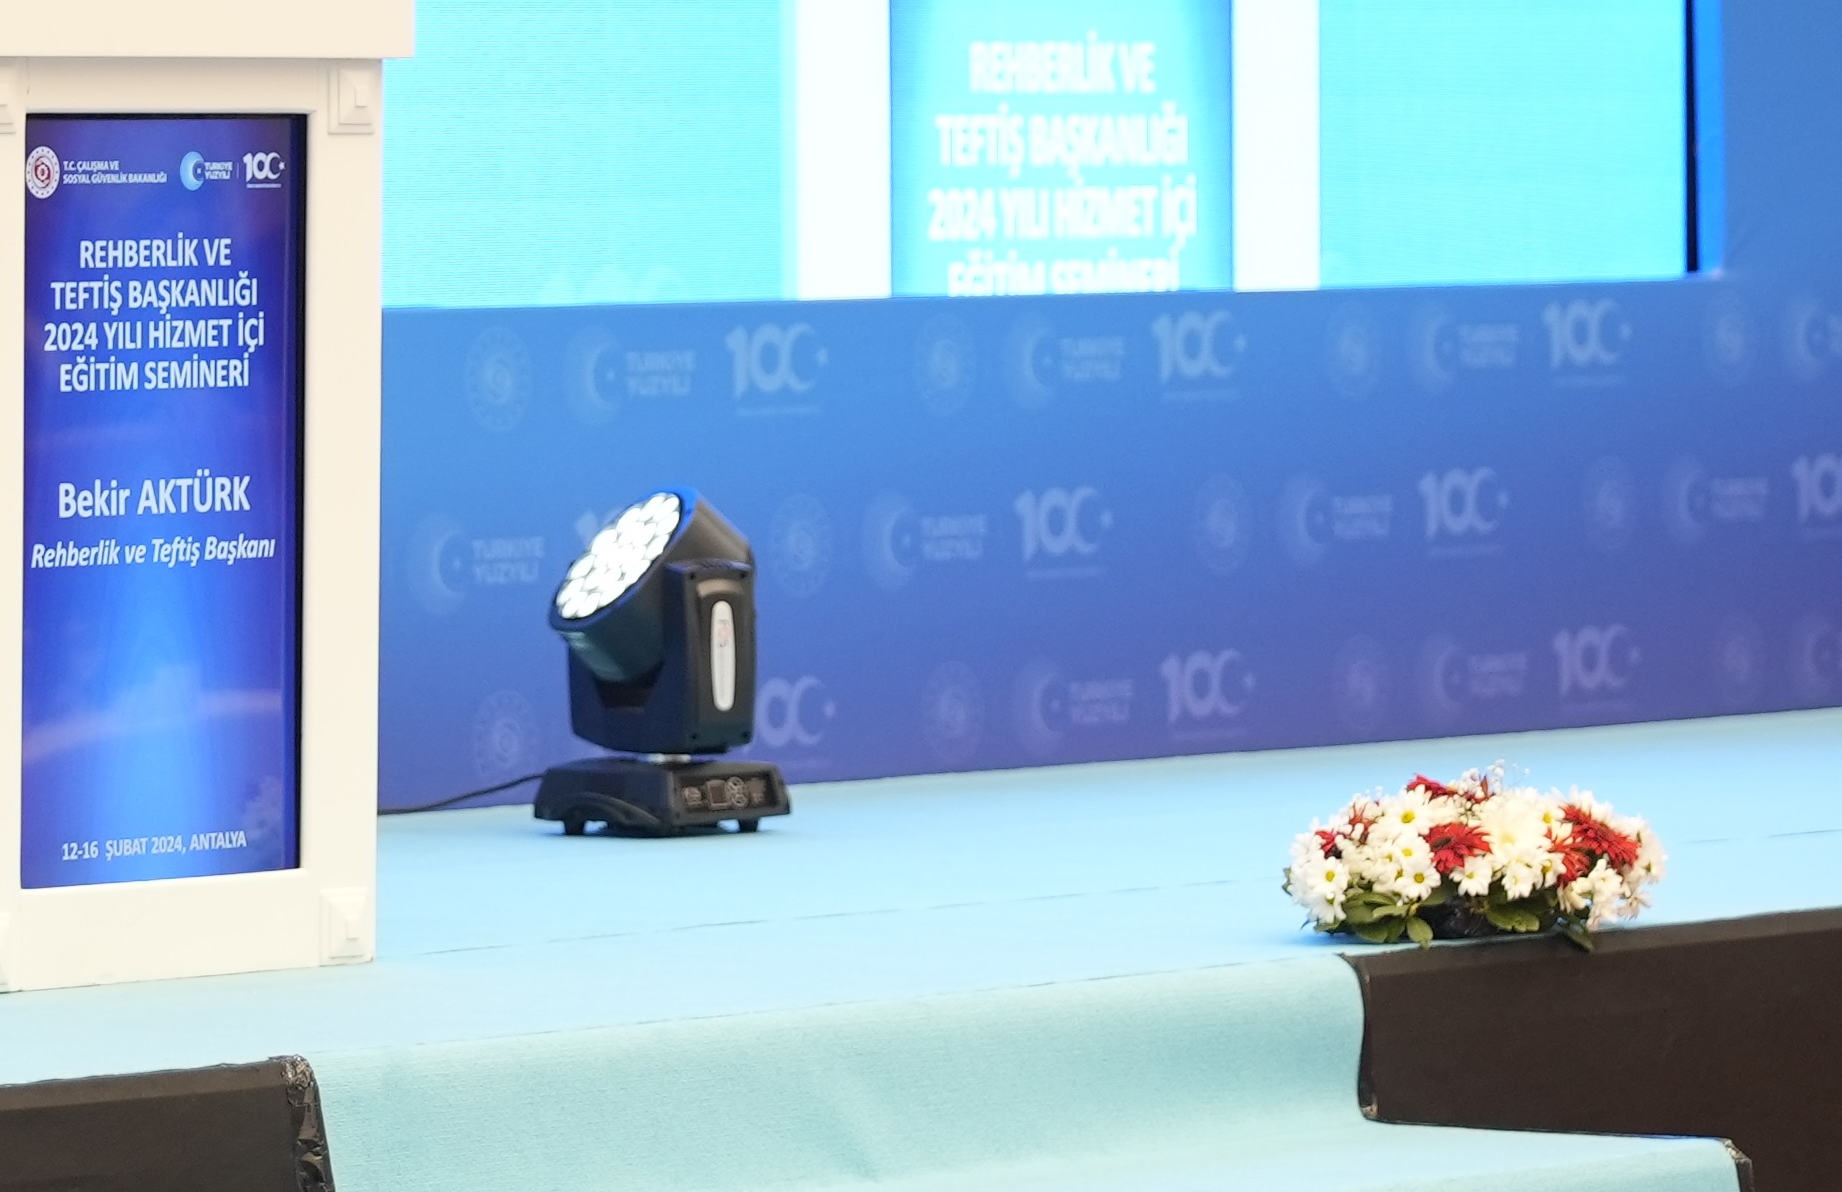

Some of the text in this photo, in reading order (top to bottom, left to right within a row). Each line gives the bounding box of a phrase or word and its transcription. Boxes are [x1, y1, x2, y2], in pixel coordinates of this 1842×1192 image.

[1117, 41, 1156, 93] VE
[63, 173, 90, 184] SOSYAL
[927, 187, 997, 241] 2024
[80, 232, 232, 269] REHBERLİK VE
[50, 271, 258, 316] TEFTİŞ BAŞKANLIĞI
[43, 311, 265, 353] 2024 YILI HİZMET İÇİ
[59, 352, 250, 392] EĞİTİM SEMİNERİ
[58, 468, 251, 518] Bekir AKTÜRK
[31, 533, 276, 569] Rehberlik ve Teftiş Başkanı
[62, 830, 247, 861] 12-16 ŞUBAT 2024, ANTALYA
